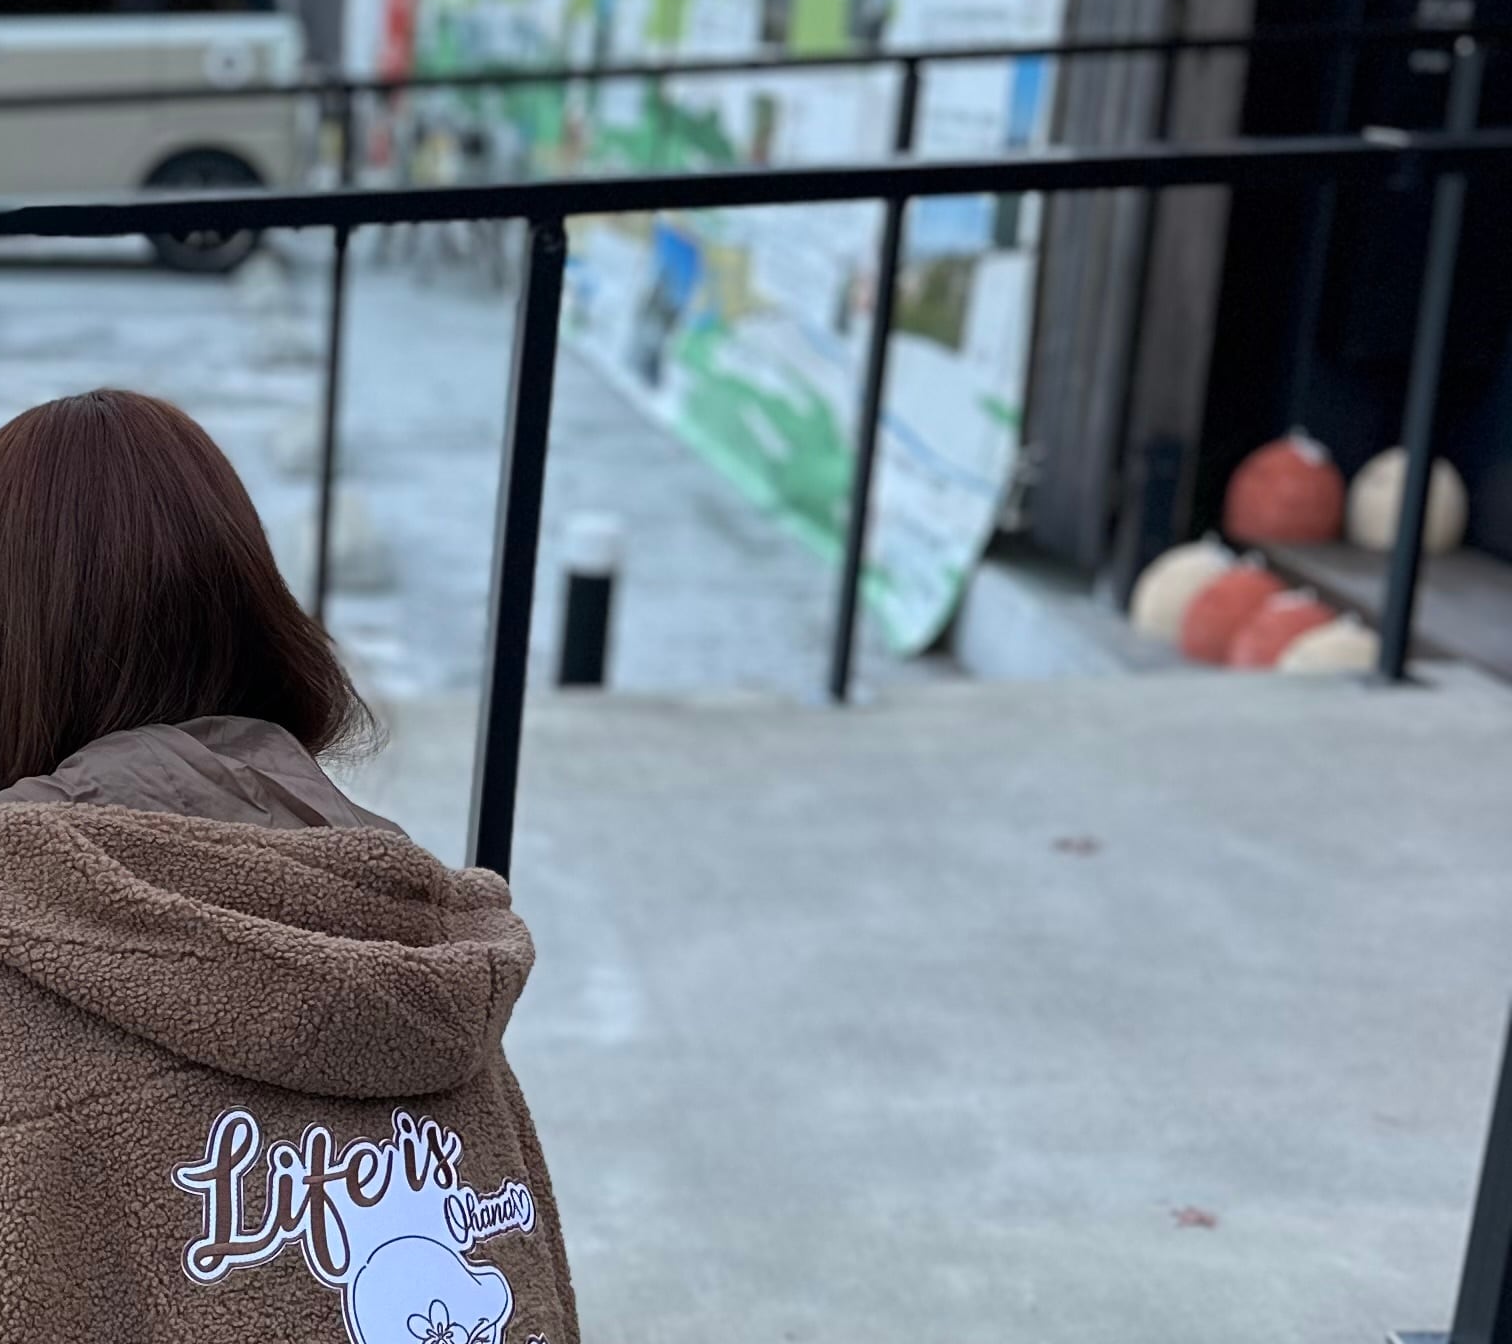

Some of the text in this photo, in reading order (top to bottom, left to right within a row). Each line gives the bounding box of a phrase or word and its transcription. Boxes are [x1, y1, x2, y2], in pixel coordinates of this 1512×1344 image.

[182, 1116, 458, 1278] Life is
[443, 1192, 517, 1244] Ohana
